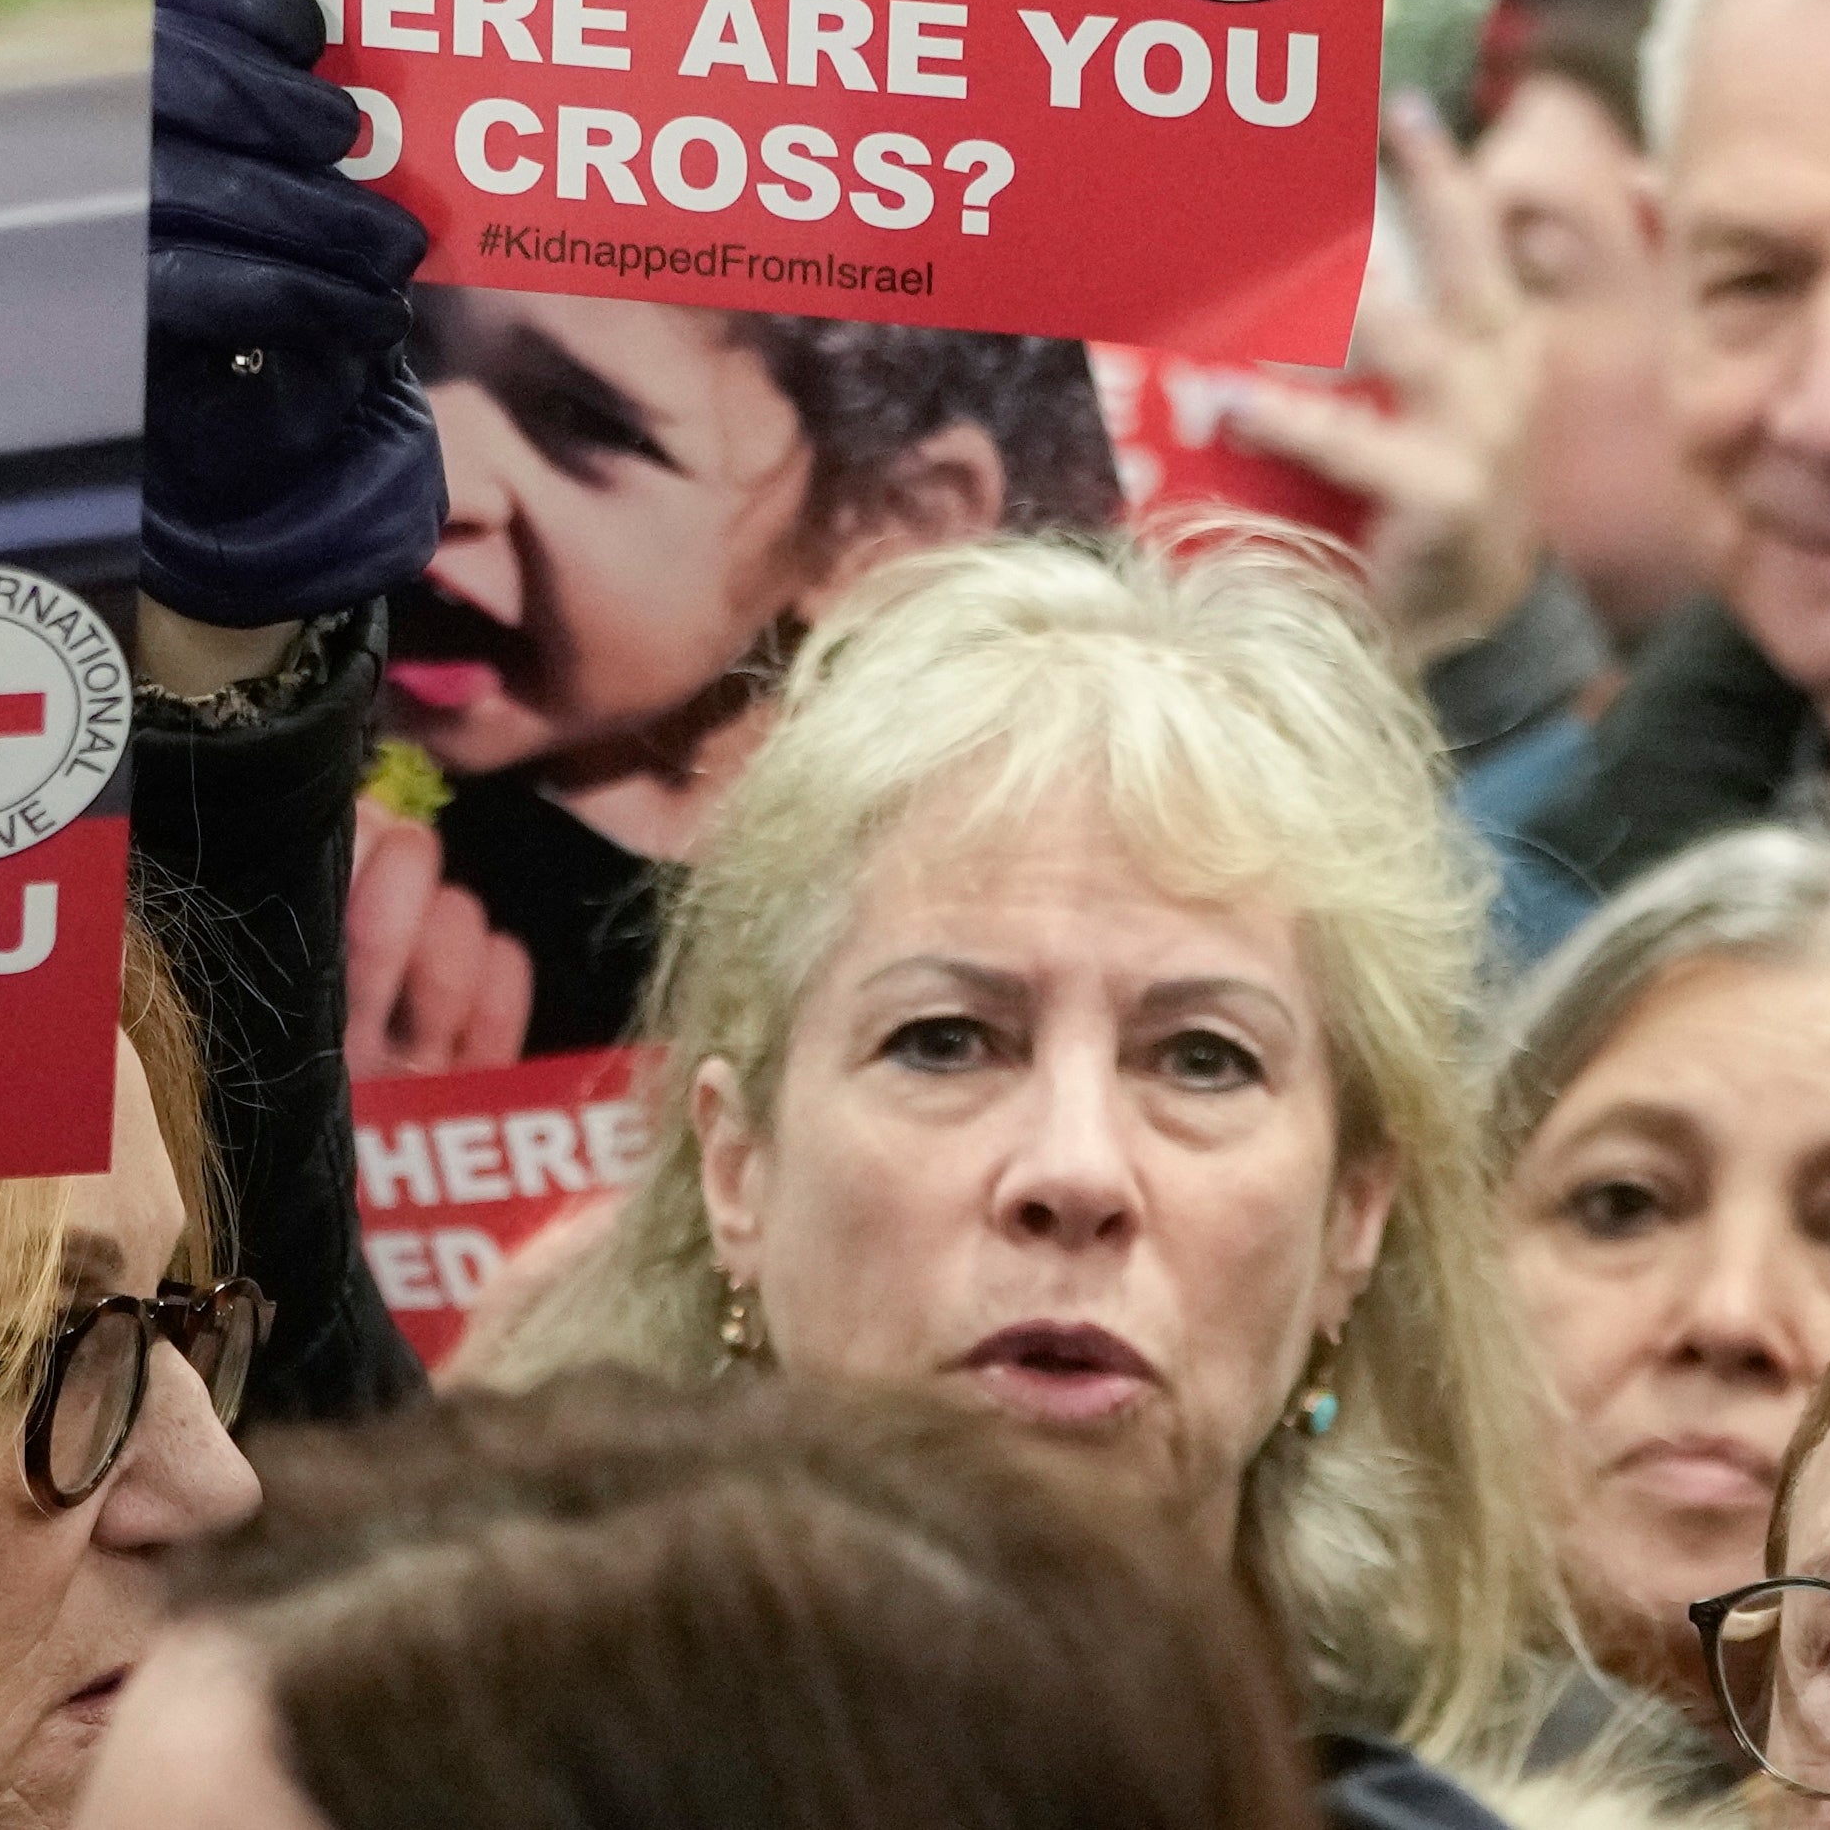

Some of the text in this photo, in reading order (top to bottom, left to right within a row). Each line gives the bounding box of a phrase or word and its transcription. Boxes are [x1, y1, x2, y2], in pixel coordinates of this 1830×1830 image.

[1015, 7, 1321, 129] YOU
[452, 97, 1017, 237] CROSS?
[478, 220, 936, 299] #KidnappedFromIsrael
[354, 1101, 648, 1209] HERE
[366, 1226, 501, 1311] ED
